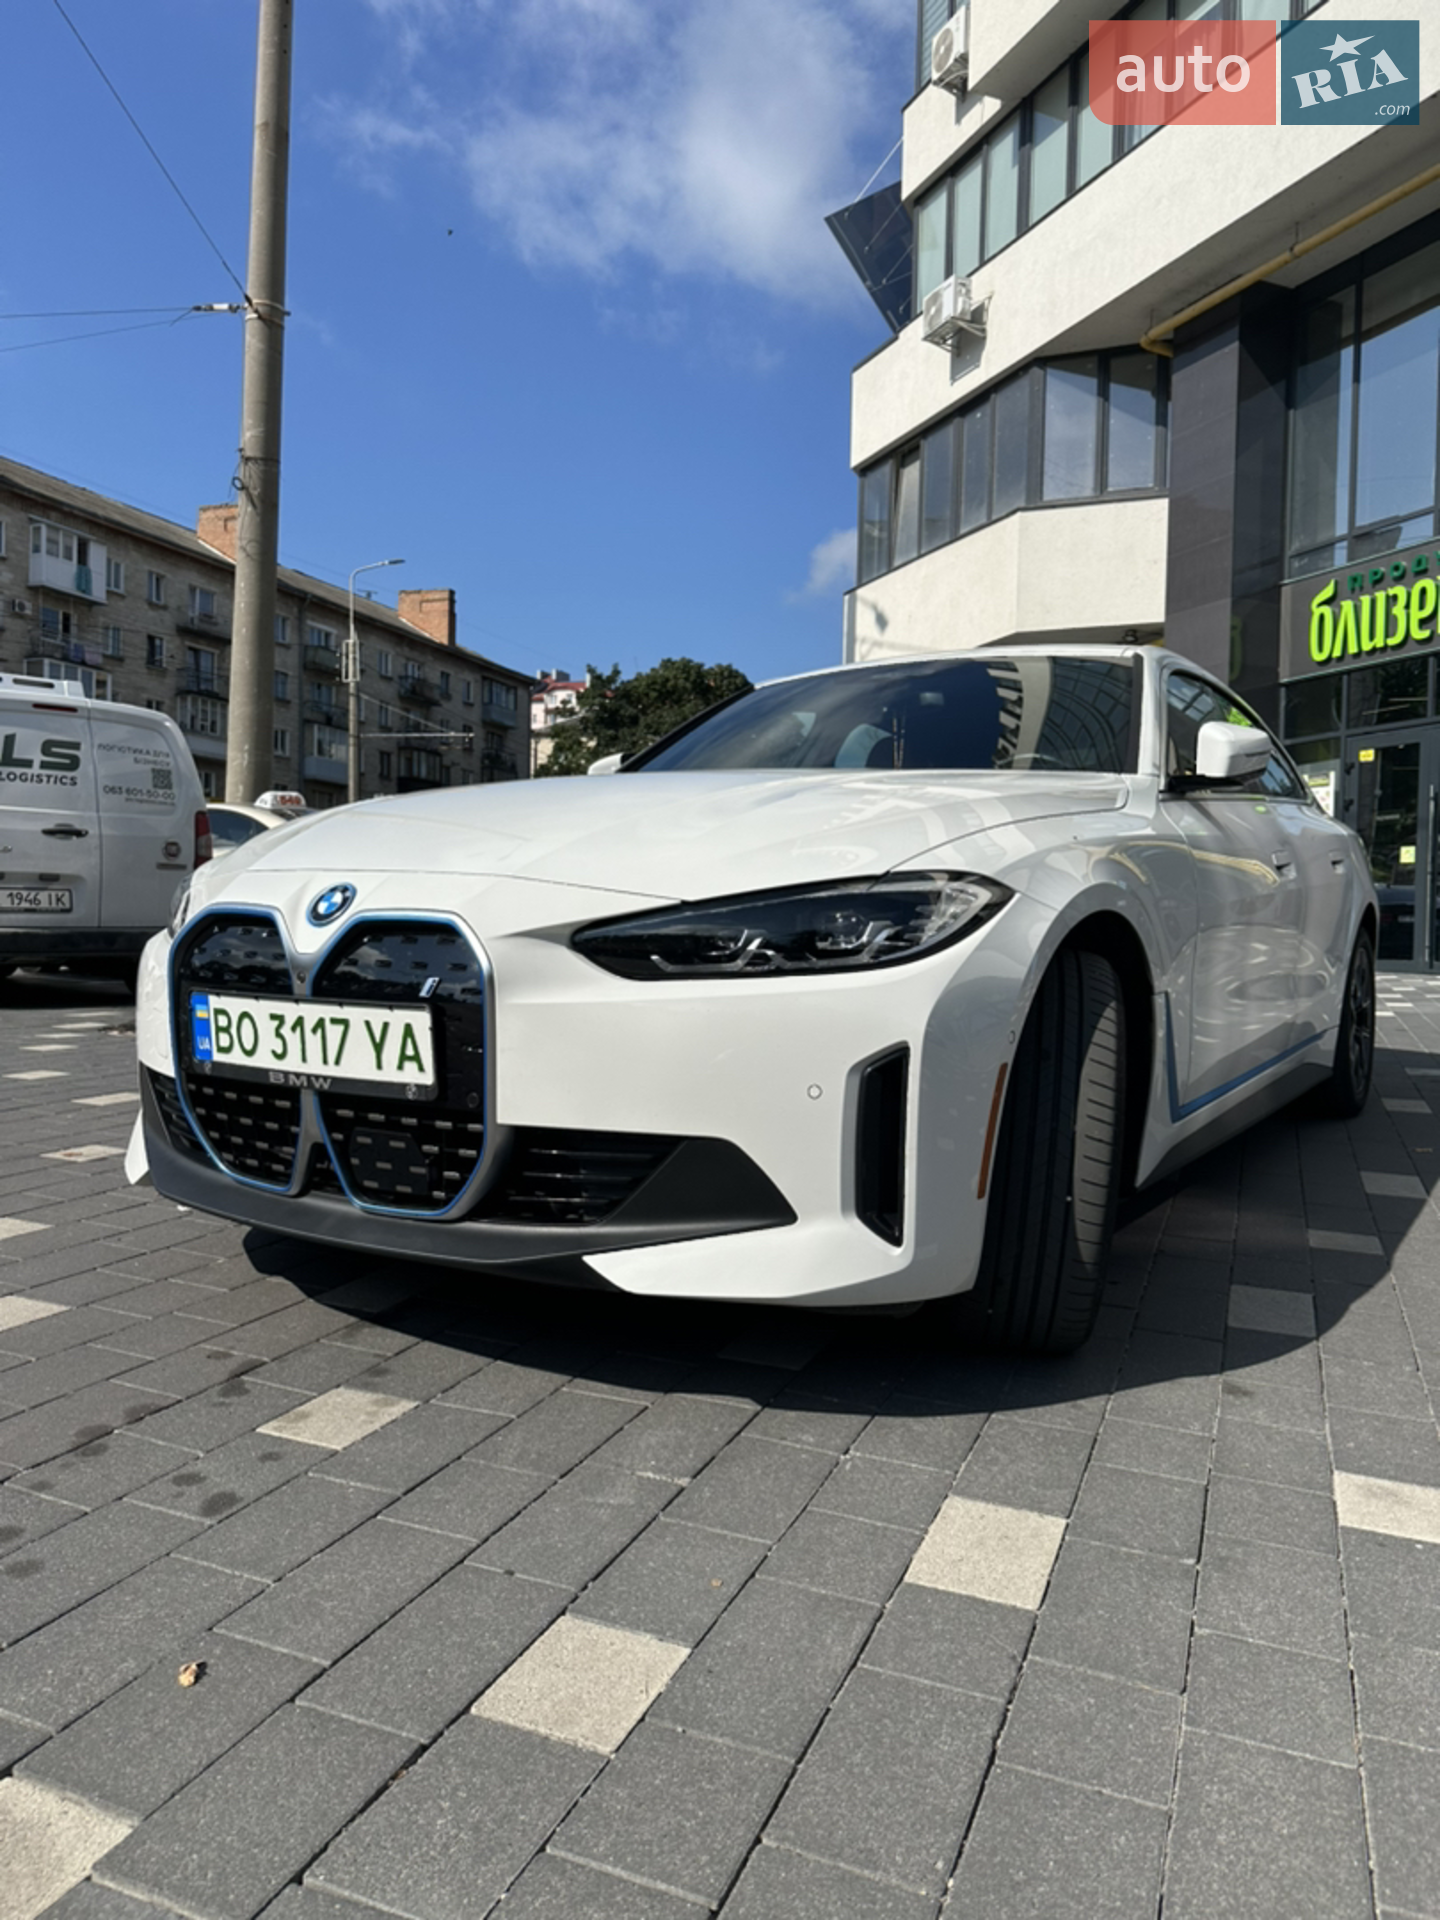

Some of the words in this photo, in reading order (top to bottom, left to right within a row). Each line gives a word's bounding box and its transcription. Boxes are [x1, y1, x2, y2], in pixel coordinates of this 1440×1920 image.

[1309, 575, 1440, 663] близе
[102, 785, 123, 795] 063
[7, 891, 42, 906] 1946
[48, 892, 66, 907] IK
[197, 1036, 211, 1051] UA
[213, 1007, 260, 1058] BO
[269, 1013, 351, 1067] 3117
[364, 1019, 426, 1073] YA
[268, 1071, 332, 1091] BMW
